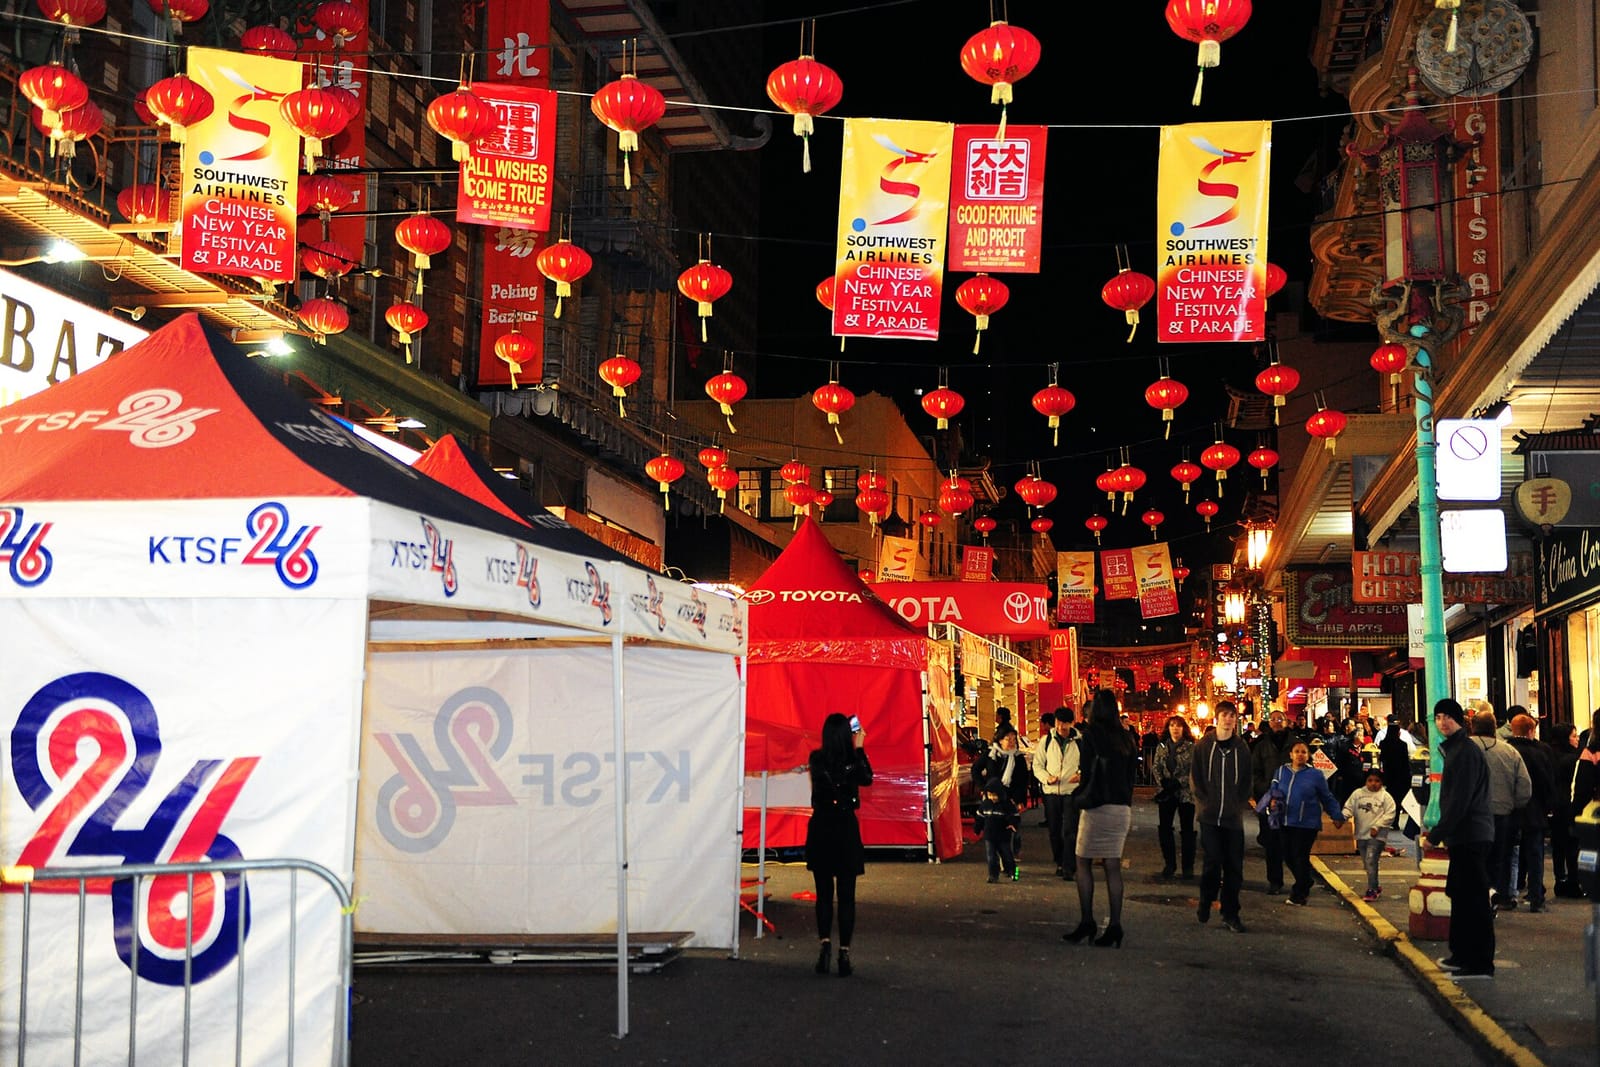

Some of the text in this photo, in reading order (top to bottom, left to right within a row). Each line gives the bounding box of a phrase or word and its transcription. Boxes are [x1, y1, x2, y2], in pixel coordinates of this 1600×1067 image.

[496, 32, 540, 76] 北
[467, 156, 548, 184] ALL WISHES
[193, 167, 289, 192] SOUTHWEST
[192, 183, 286, 206] AIRLINES
[466, 177, 545, 205] COME TRUE
[205, 199, 276, 222] CHINESE
[957, 205, 1037, 225] GOOD FORTUNE
[192, 214, 287, 241] NEW YEAR
[201, 232, 277, 256] FESTIVAL
[847, 235, 937, 250] SOUTHWEST
[966, 228, 1027, 247] AND PROFIT
[1166, 238, 1258, 251] SOUTHWEST
[192, 250, 283, 273] & PARADE
[846, 250, 933, 265] AIRLINES
[1166, 253, 1255, 266] AIRLINES
[857, 264, 922, 280] CHINESE
[1177, 268, 1245, 284] CHINESE
[491, 284, 538, 301] Peking
[844, 279, 933, 298] NEW YEAR
[1166, 285, 1257, 300] NEW YEAR
[852, 296, 923, 314] FESTIVAL
[1175, 302, 1248, 317] FESTIVAL
[488, 308, 538, 324] Bazaar
[844, 313, 928, 330] & PARADE
[1168, 319, 1253, 333] & PARADE
[149, 536, 242, 565] KTSF
[390, 540, 428, 571] KTSF
[486, 556, 517, 584] KTSF
[1549, 540, 1578, 592] China
[881, 572, 911, 580] SOUTHWEST
[780, 590, 862, 603] TOYOTA
[1361, 580, 1416, 599] GIFTS
[1351, 605, 1407, 614] JEWELRY
[1315, 624, 1383, 633] FINE ARTS
